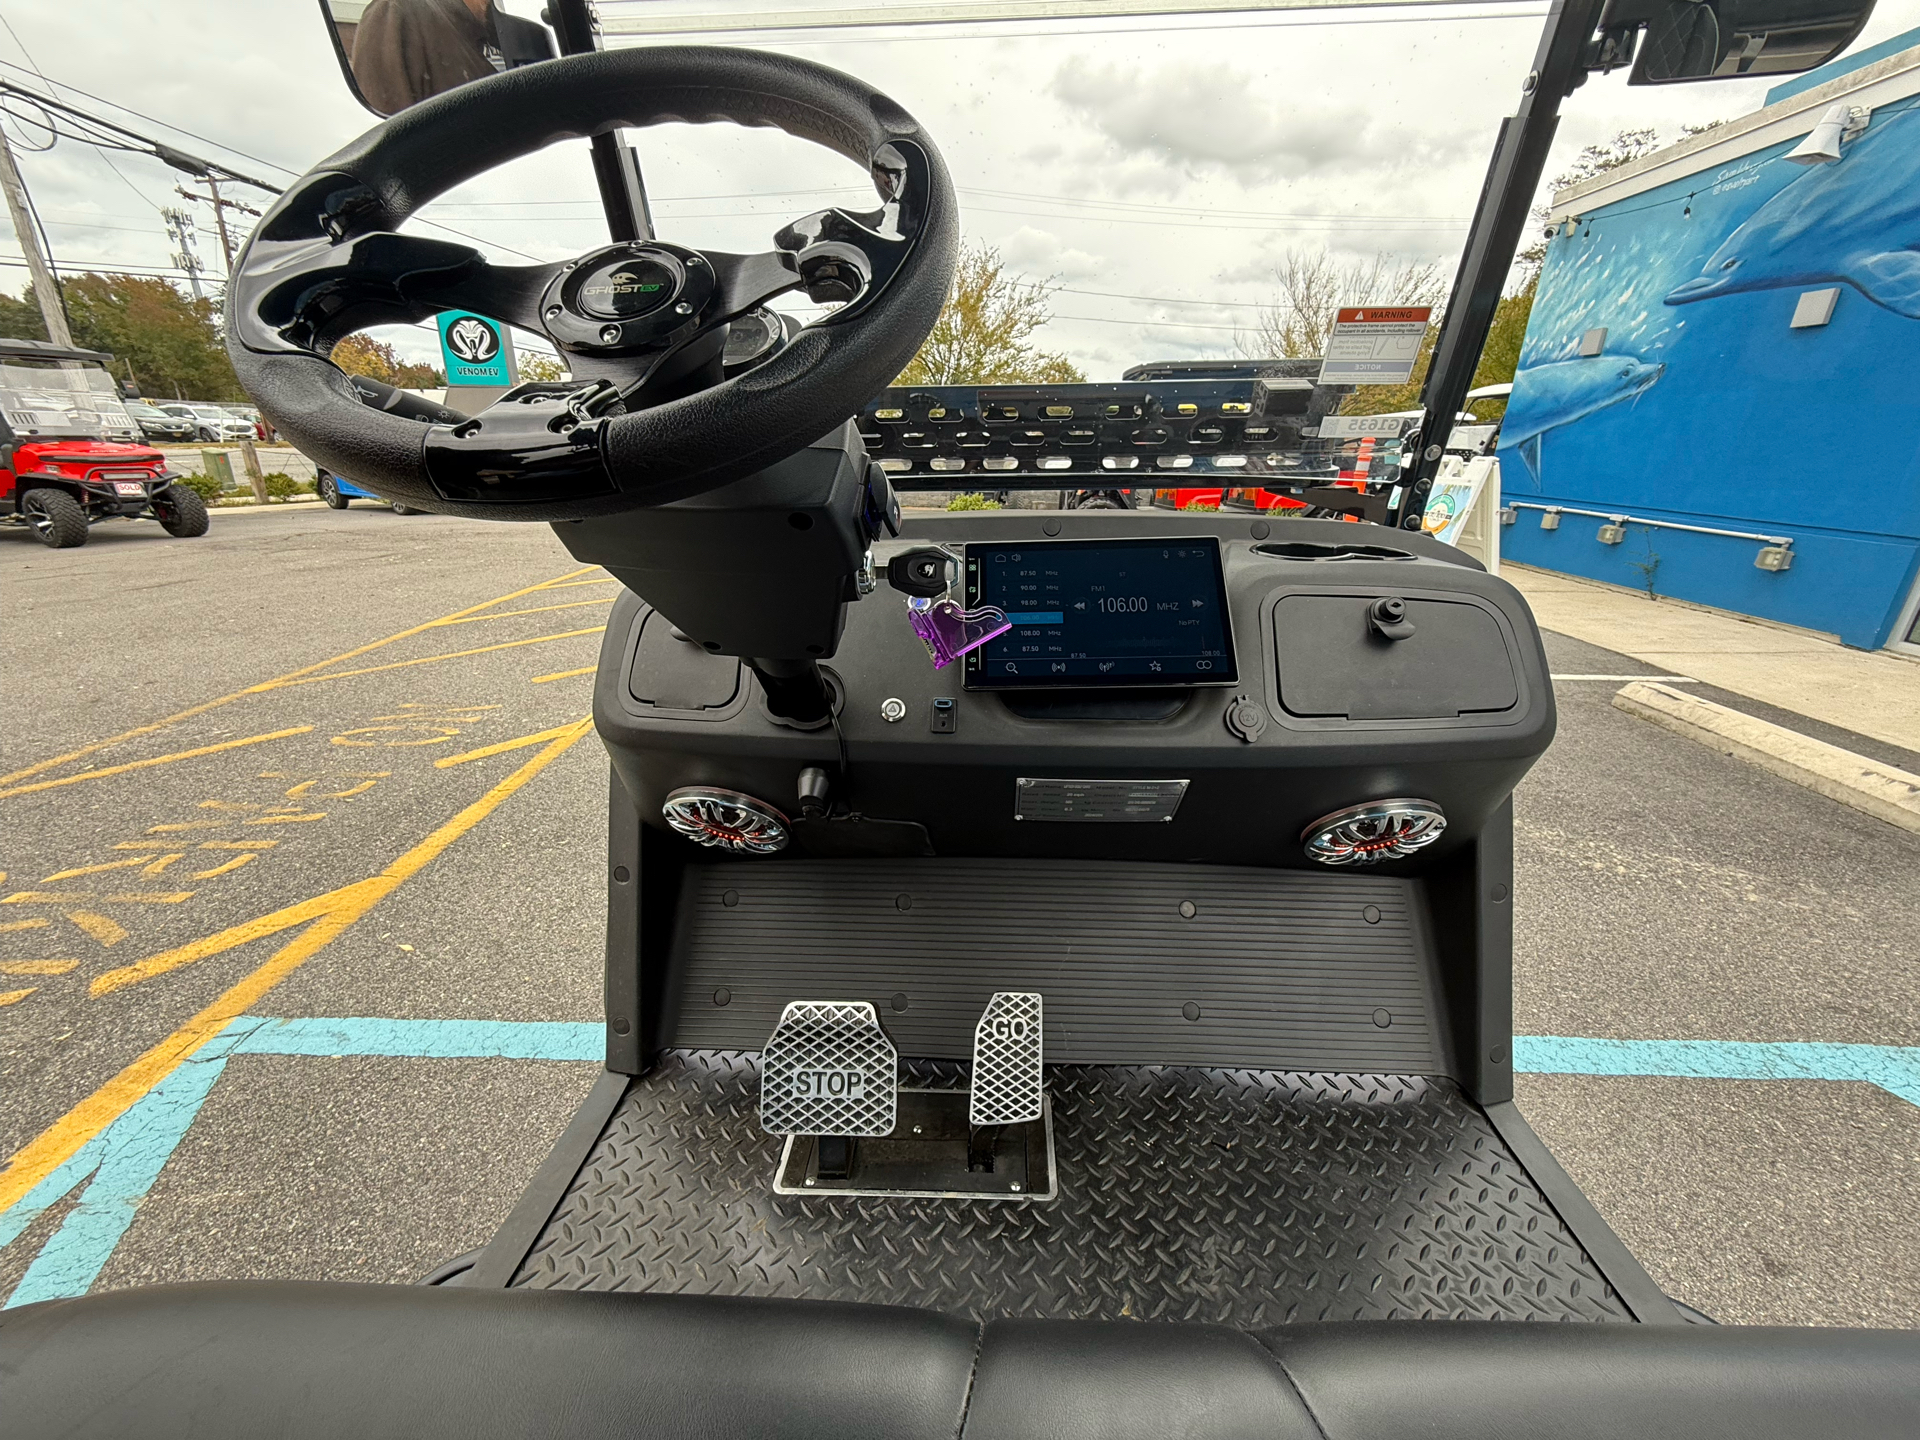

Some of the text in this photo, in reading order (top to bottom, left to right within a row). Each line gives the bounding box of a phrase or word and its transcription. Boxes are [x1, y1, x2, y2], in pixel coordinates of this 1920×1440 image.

[584, 284, 642, 295] GHOST
[1370, 311, 1413, 319] WARNING
[457, 367, 499, 376] VENOM EV
[1098, 597, 1179, 613] 106.00 MHZ
[1241, 714, 1255, 722] 12V
[992, 1018, 1027, 1040] GO
[796, 1071, 862, 1096] STOP
